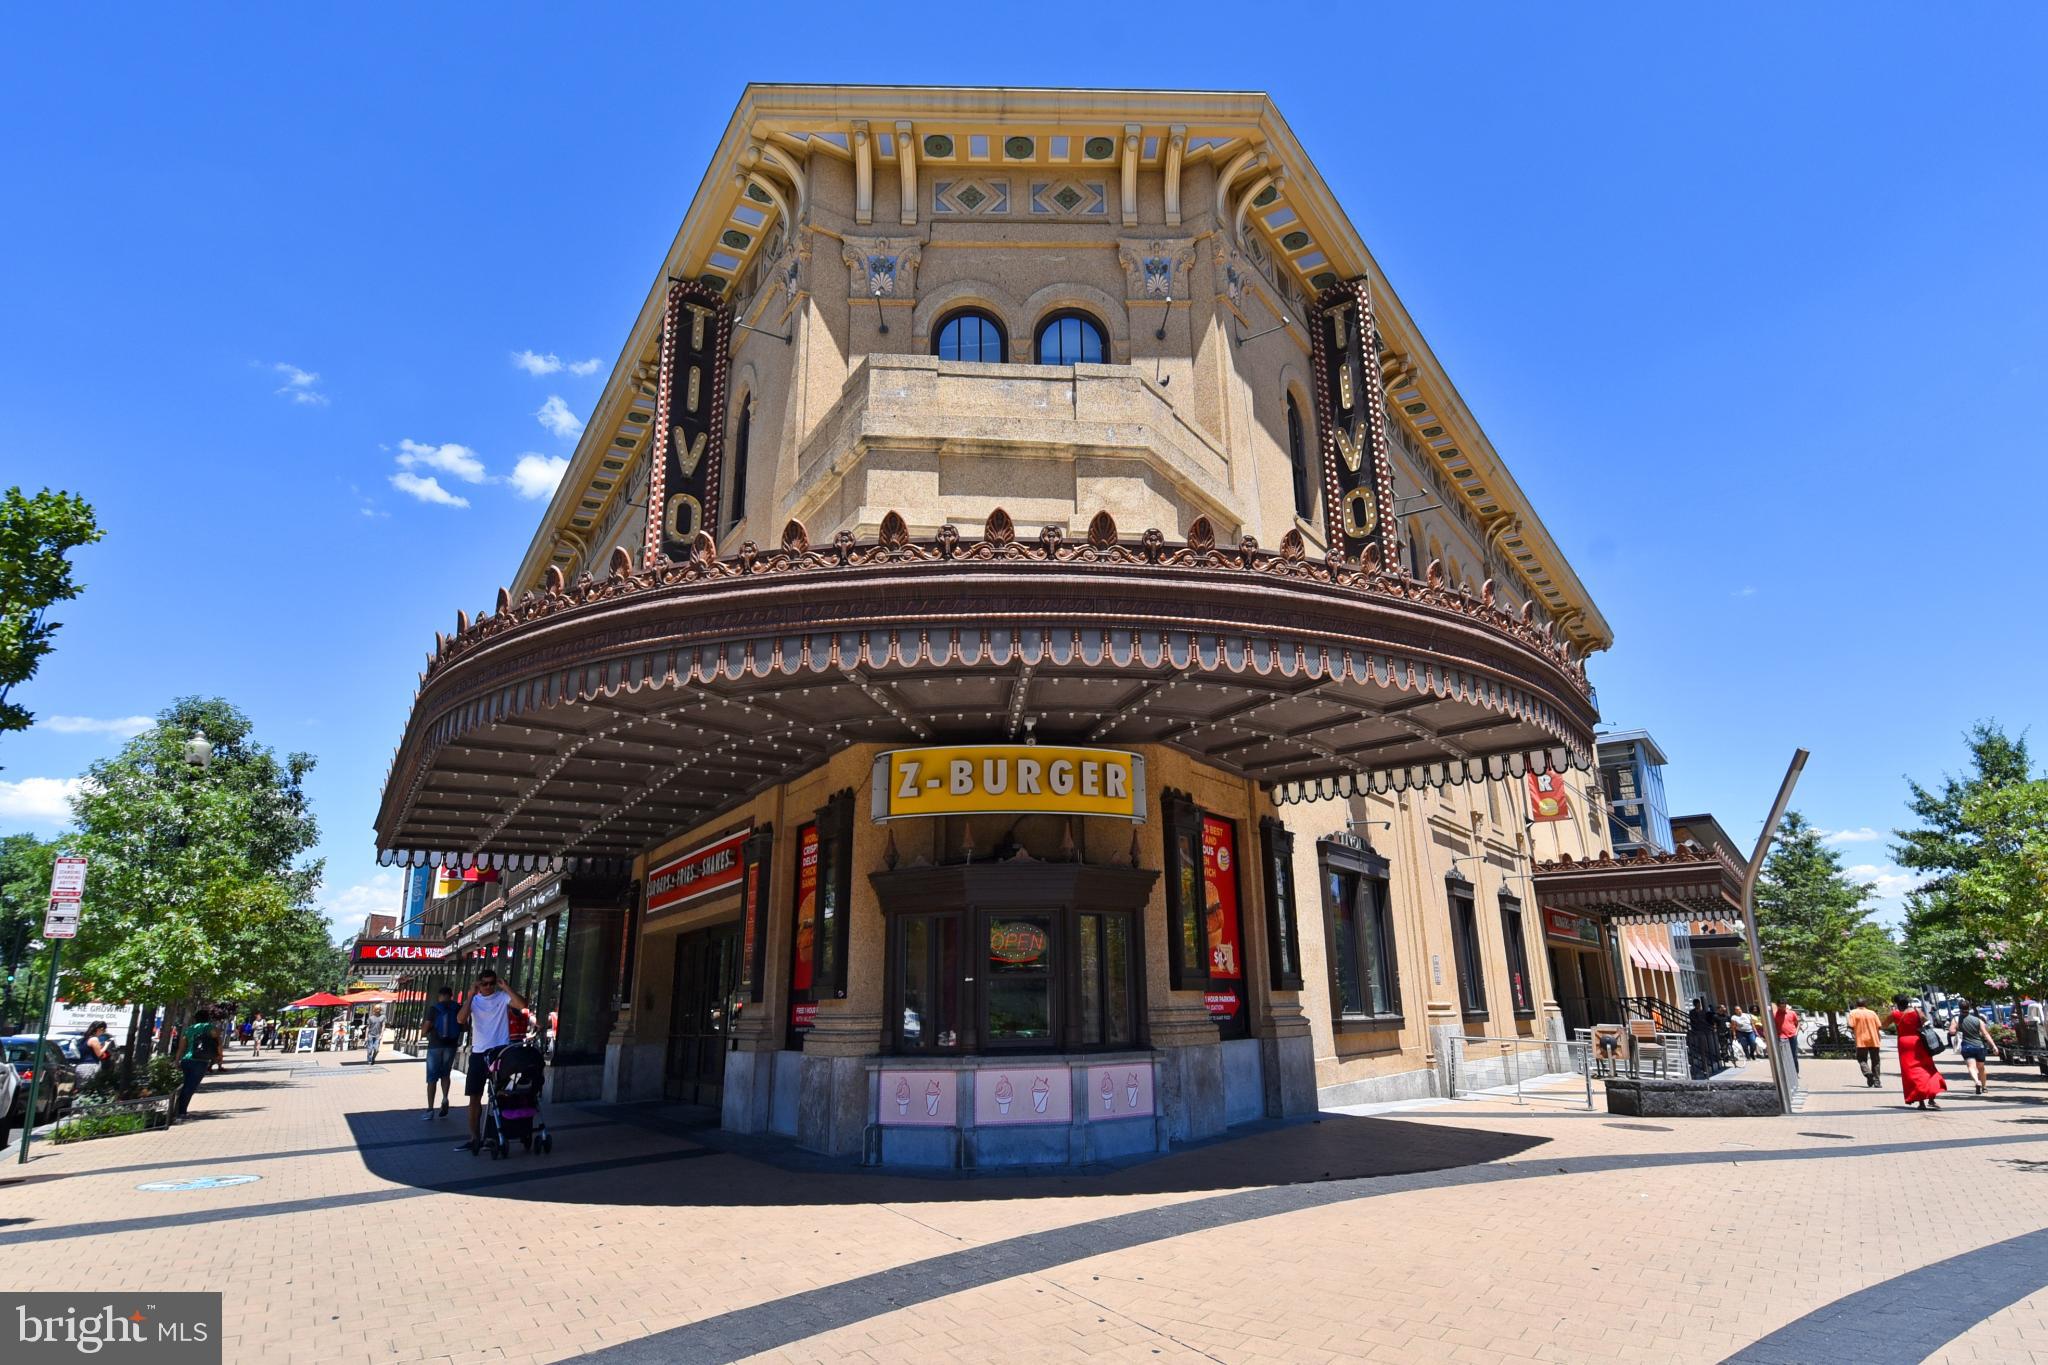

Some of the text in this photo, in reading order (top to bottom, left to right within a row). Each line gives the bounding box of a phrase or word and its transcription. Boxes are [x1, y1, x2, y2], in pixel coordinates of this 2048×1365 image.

[897, 758, 1128, 799] Z-BURGER
[676, 863, 696, 887] FRIES
[701, 849, 731, 877] SHAKES
[375, 945, 423, 959] GALA
[990, 933, 1045, 951] OPEN
